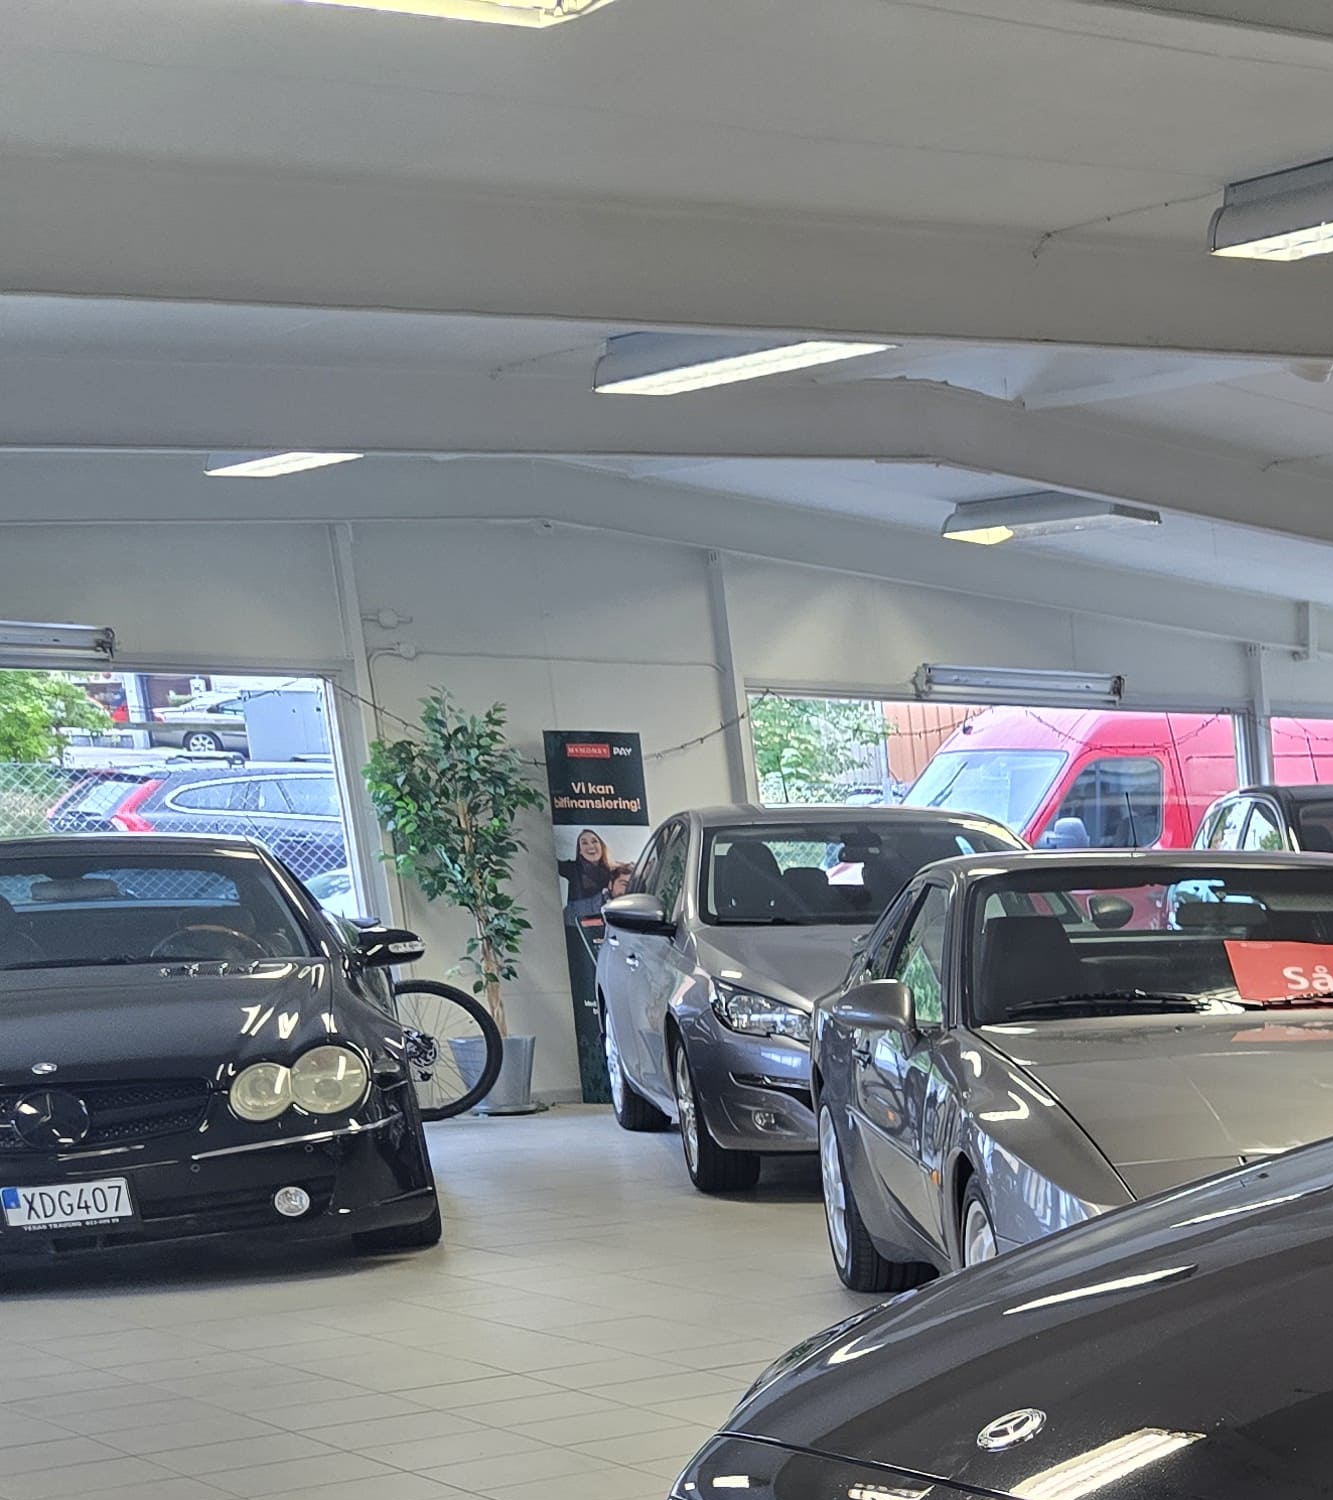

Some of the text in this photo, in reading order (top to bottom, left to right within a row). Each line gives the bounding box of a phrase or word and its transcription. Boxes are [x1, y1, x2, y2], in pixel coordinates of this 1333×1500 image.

[612, 746, 632, 756] PAY
[571, 781, 615, 794] Vi kan
[22, 1185, 122, 1220] XDG407
